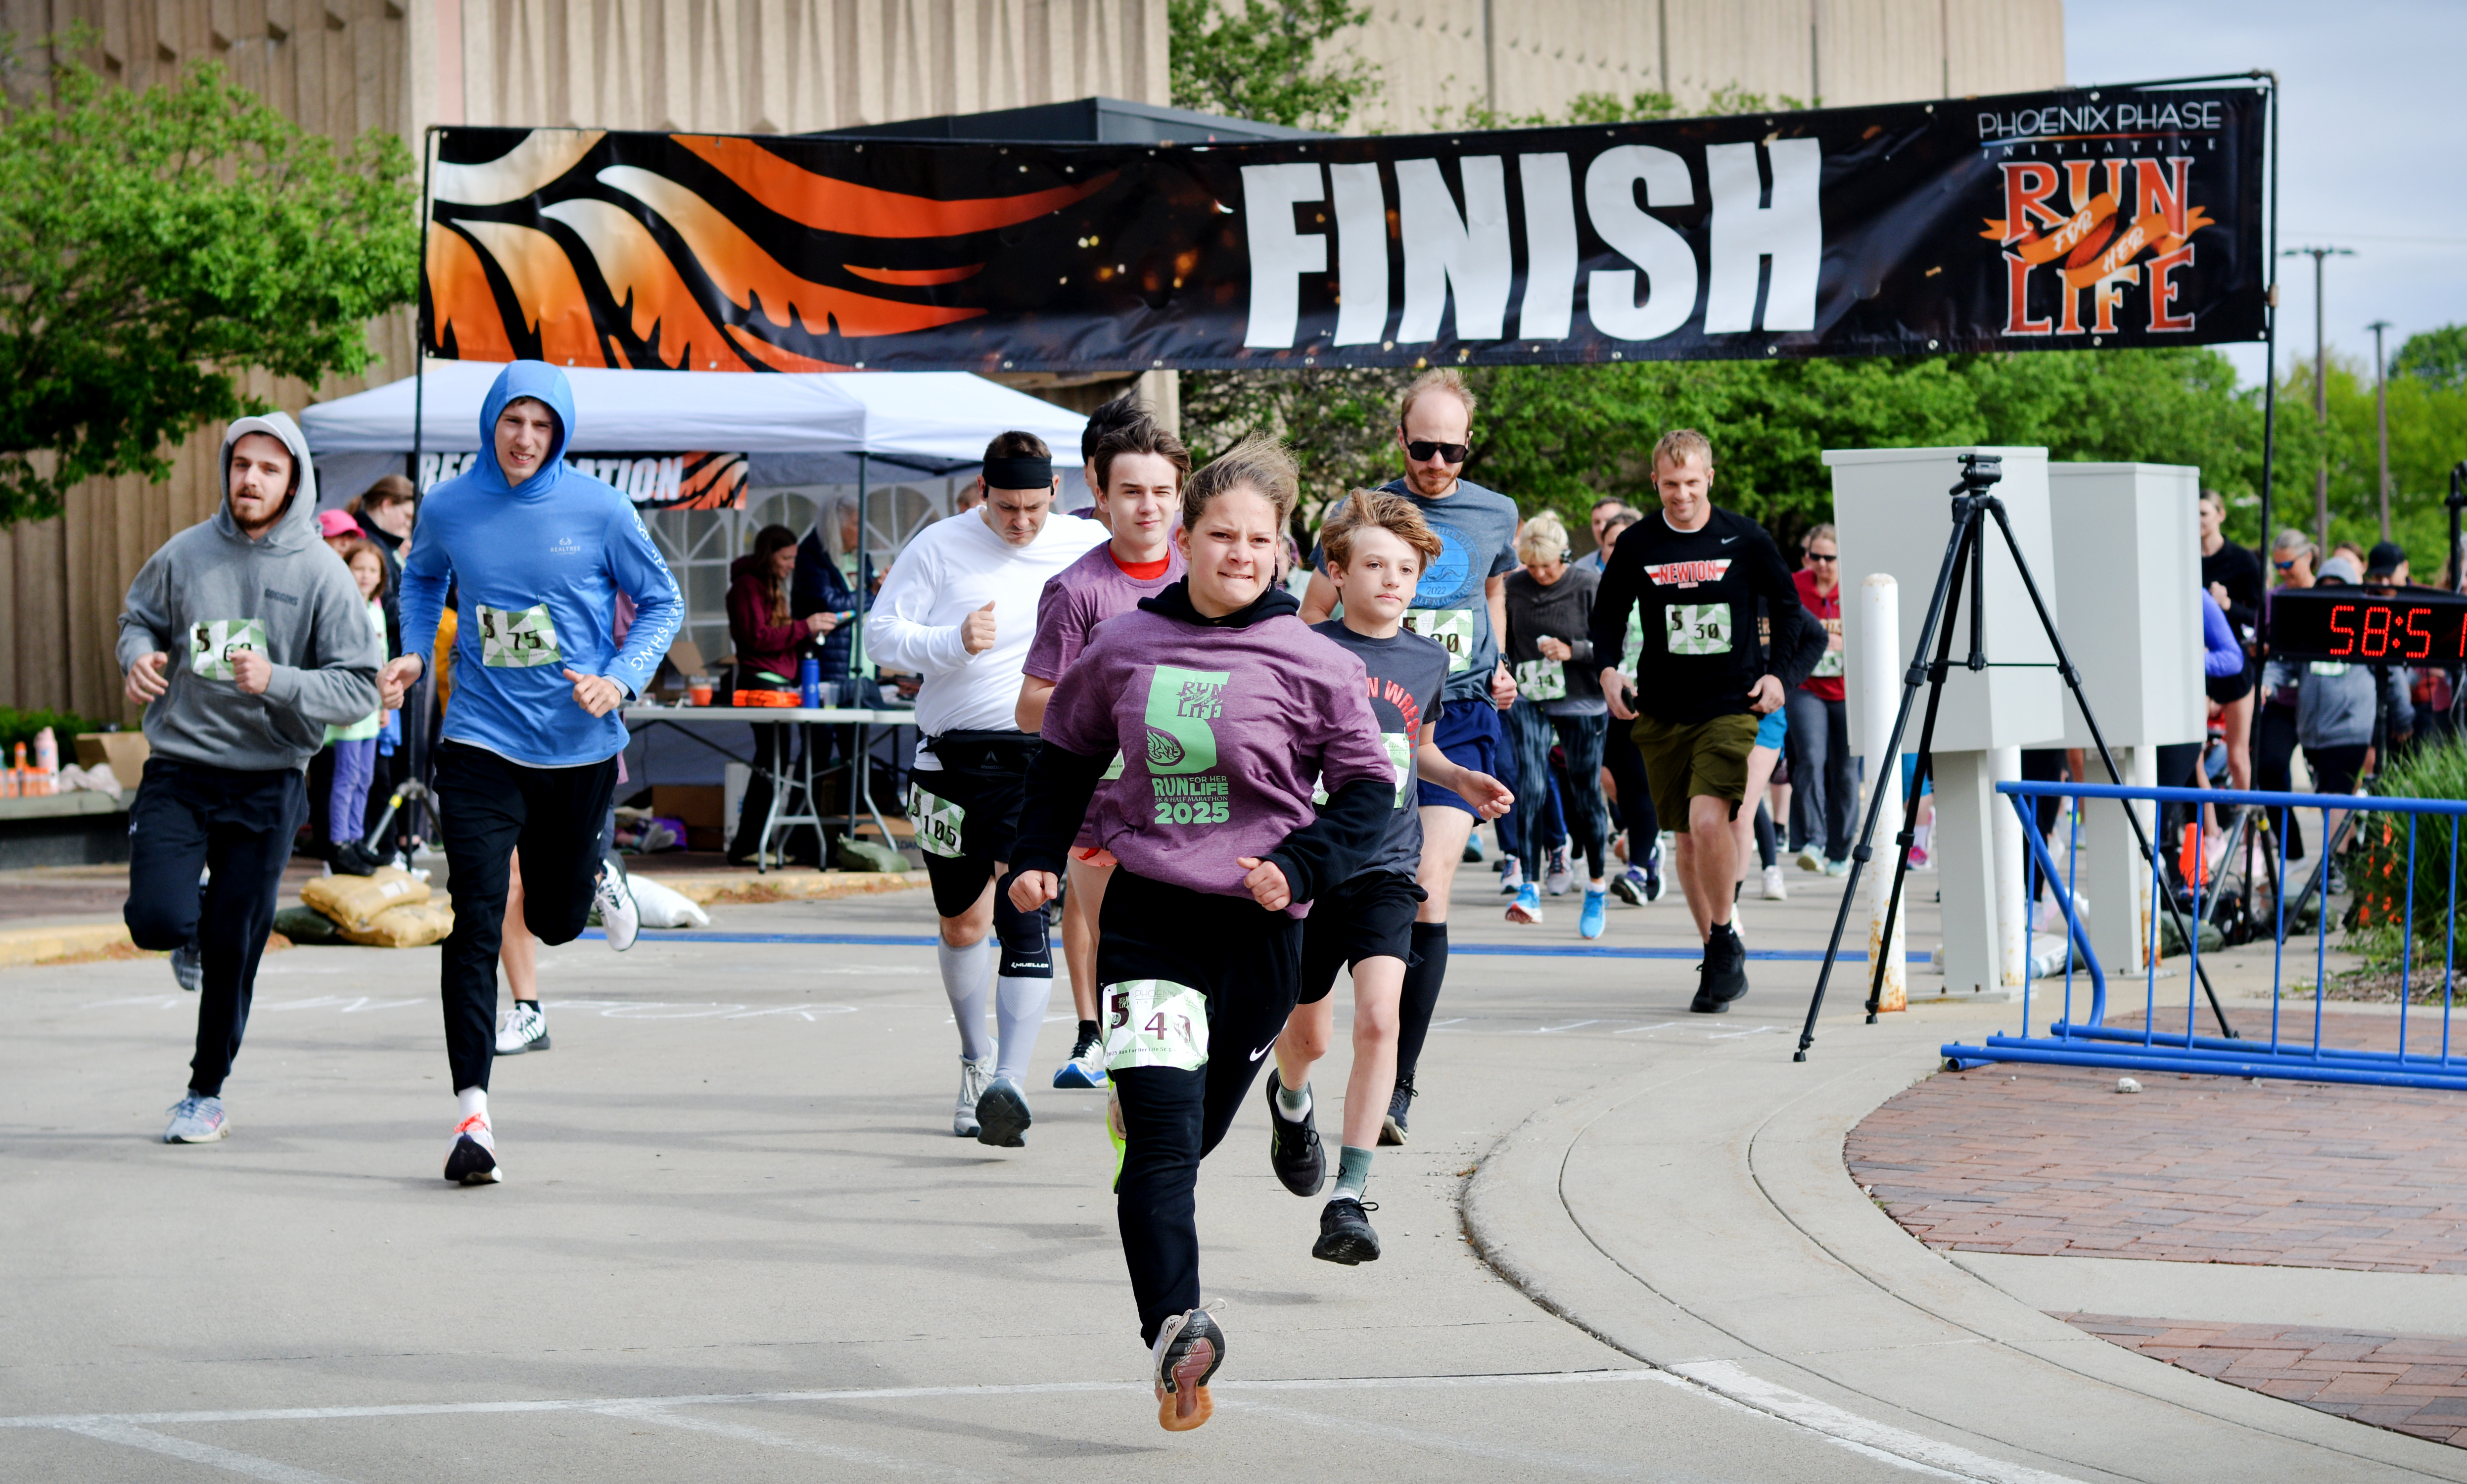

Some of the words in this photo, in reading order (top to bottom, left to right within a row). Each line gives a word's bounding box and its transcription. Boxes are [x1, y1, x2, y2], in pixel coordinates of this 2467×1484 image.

[1979, 106, 2110, 138] PHOENIX
[2117, 101, 2222, 132] PHASE
[1983, 138, 2216, 159] INITIATIVE
[1998, 156, 2195, 247] RUN
[1240, 137, 1822, 348] FINISH
[2052, 209, 2094, 252] FOR
[2102, 224, 2144, 274] HER
[2002, 243, 2195, 337] LIFE
[1659, 560, 1718, 585] NEWTON
[483, 613, 495, 639] 5
[507, 630, 541, 650] 75
[1672, 611, 1682, 631] 5
[1694, 623, 1719, 639] 30
[197, 629, 211, 652] 5
[1182, 681, 1227, 696] RUN
[1176, 699, 1222, 719] LIFE
[1152, 777, 1188, 796] RUN
[1190, 783, 1229, 796] LIFE
[1154, 801, 1230, 825] 2025
[924, 815, 957, 847] 105
